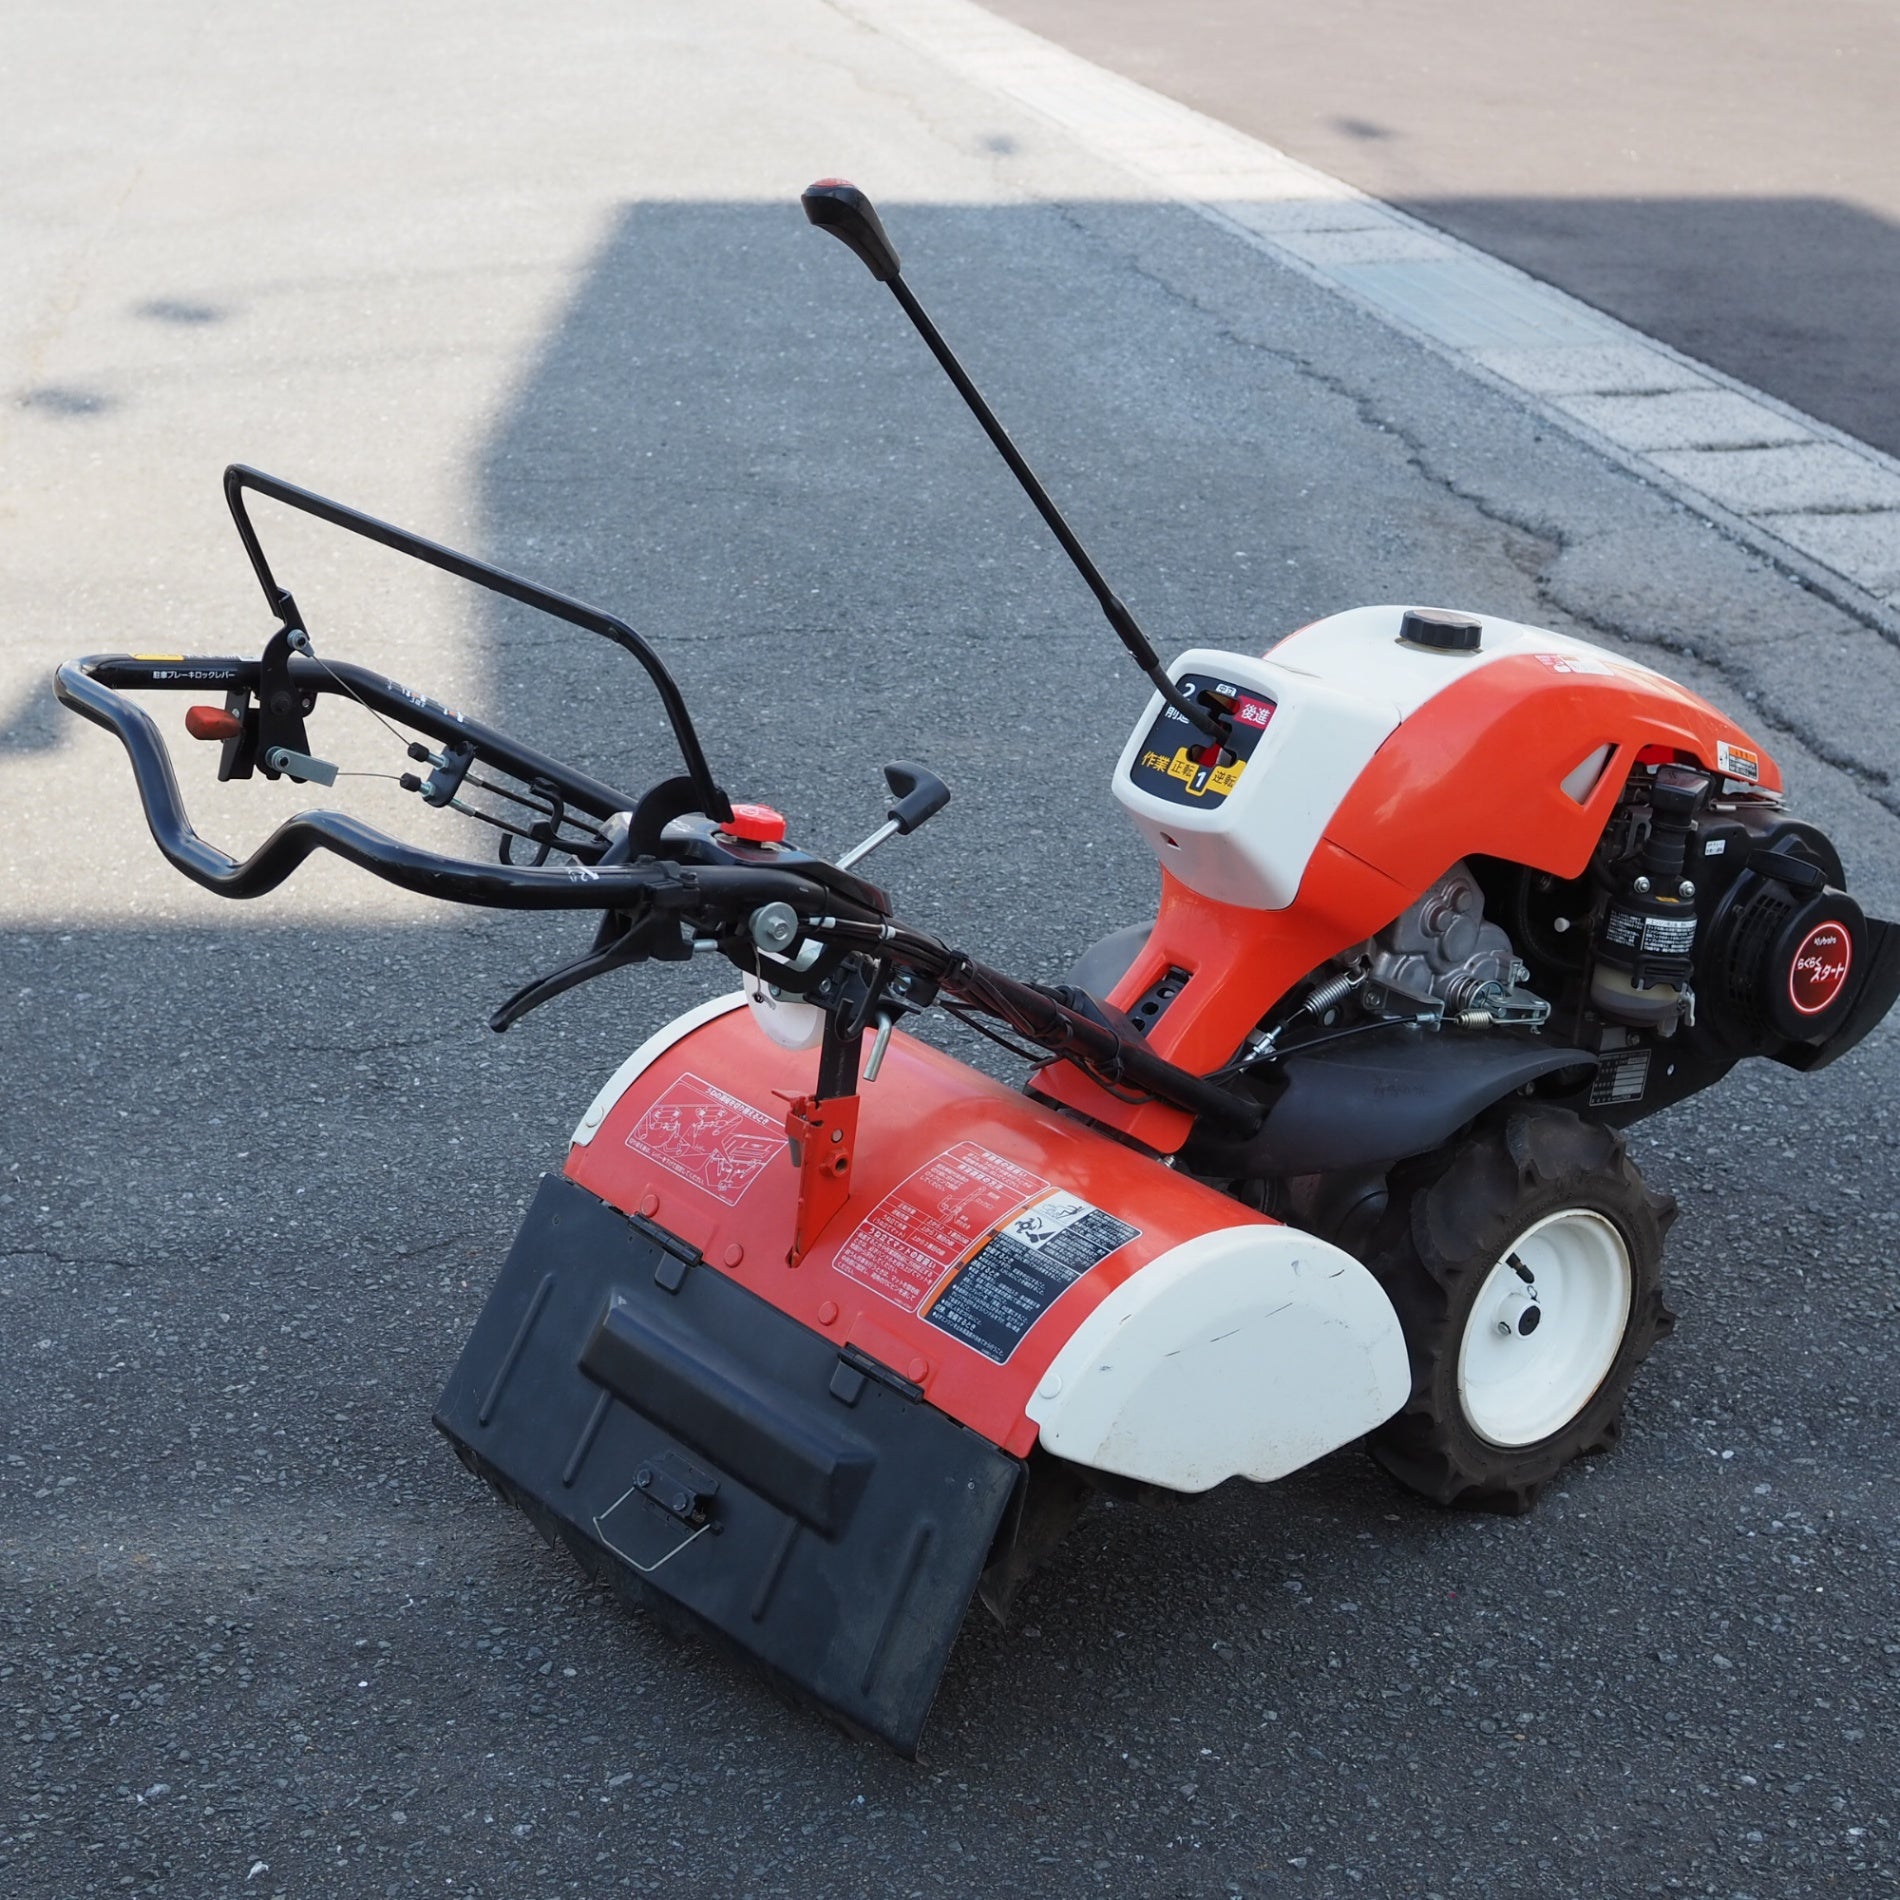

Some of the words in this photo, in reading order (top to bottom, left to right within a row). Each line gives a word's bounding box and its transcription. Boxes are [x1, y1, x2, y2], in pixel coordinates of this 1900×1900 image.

[153, 671, 235, 679] 駐車ブレーキロックレバー
[1182, 682, 1195, 700] 2
[1241, 703, 1271, 725] 後進
[1141, 751, 1170, 772] 作業
[1171, 760, 1195, 777] 正転
[1196, 771, 1207, 788] 1
[1212, 771, 1237, 787] 逆転
[1814, 936, 1837, 946] Kubota
[1797, 956, 1822, 970] らくらく
[1810, 963, 1844, 983] スタート
